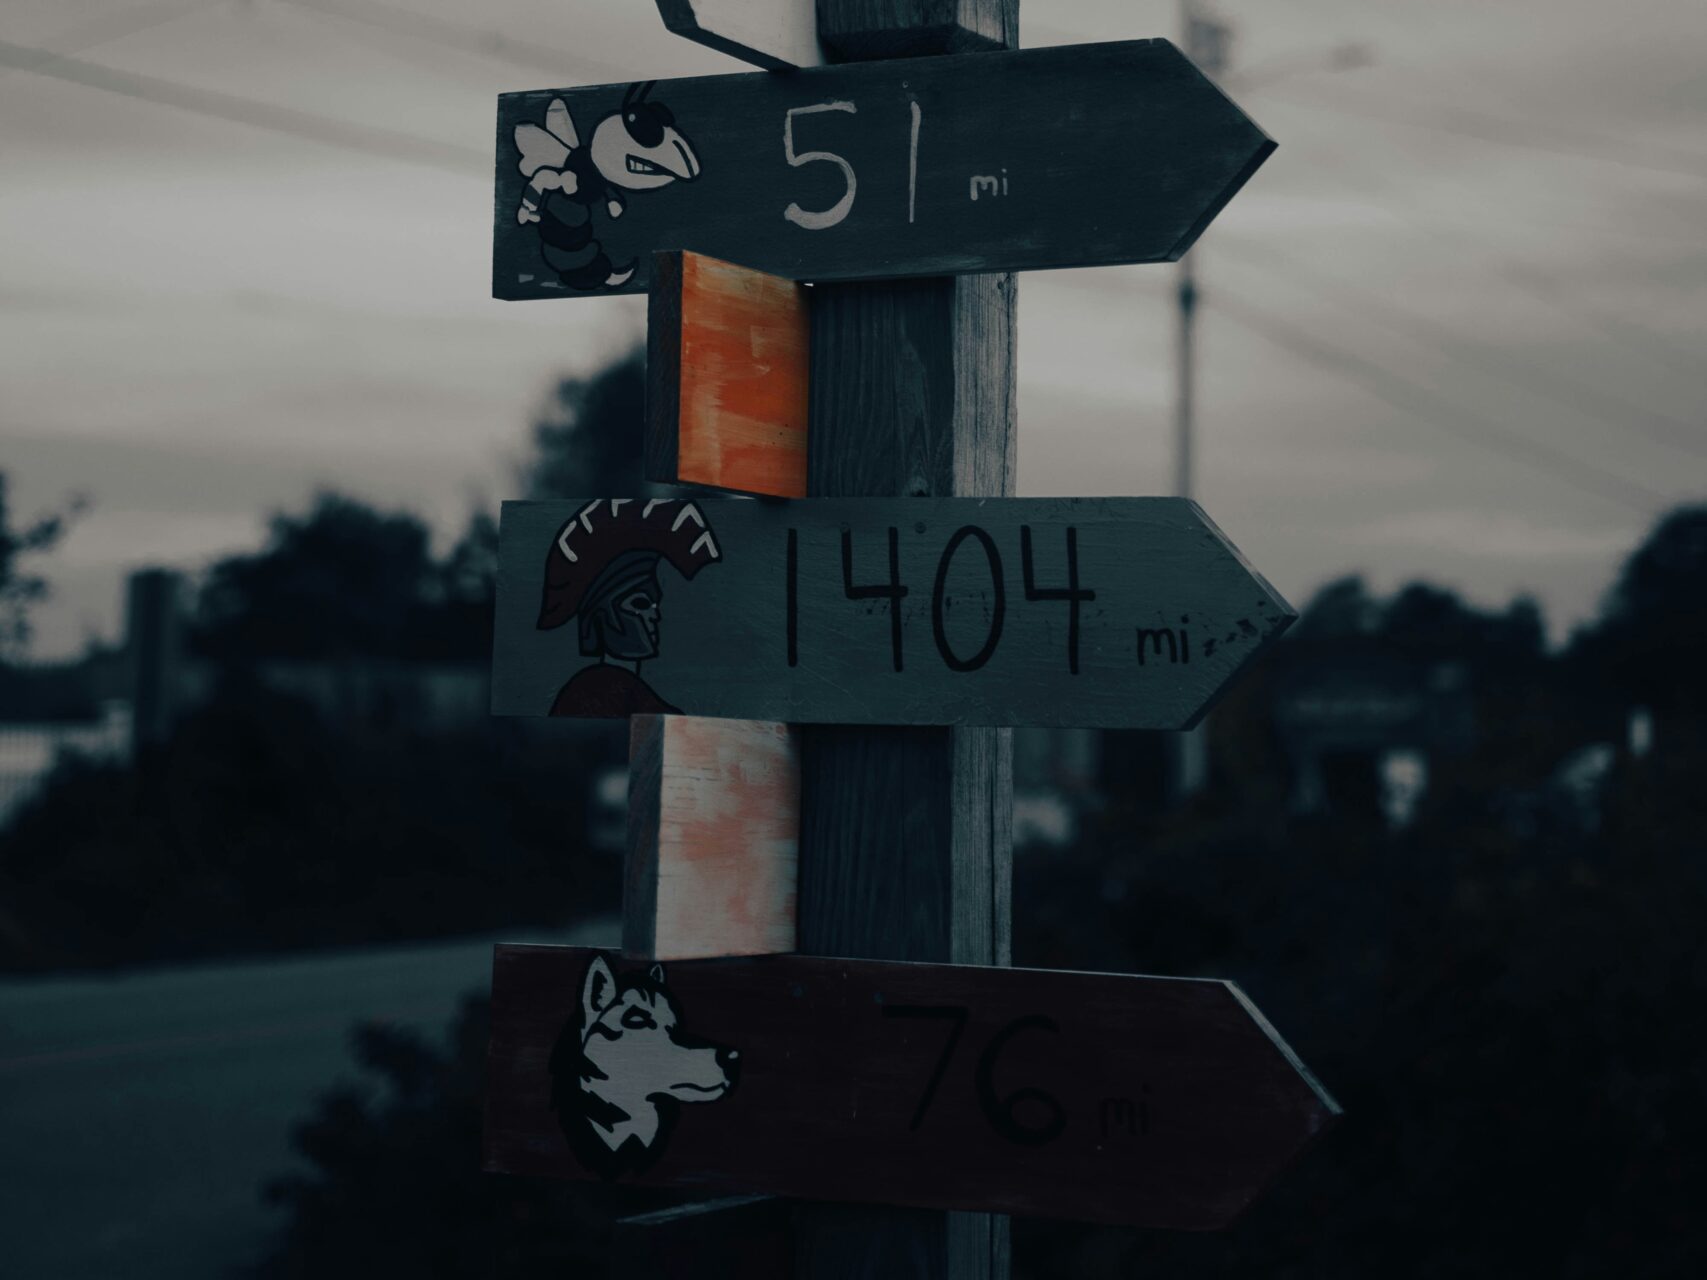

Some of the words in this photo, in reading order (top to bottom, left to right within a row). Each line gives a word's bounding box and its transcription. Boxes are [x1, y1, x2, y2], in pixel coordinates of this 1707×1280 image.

[783, 100, 922, 230] 51
[970, 168, 1008, 201] mi
[787, 524, 1096, 675] 1404
[1137, 615, 1189, 666] mi
[881, 1004, 1067, 1147] 76
[1100, 1083, 1152, 1139] mi
